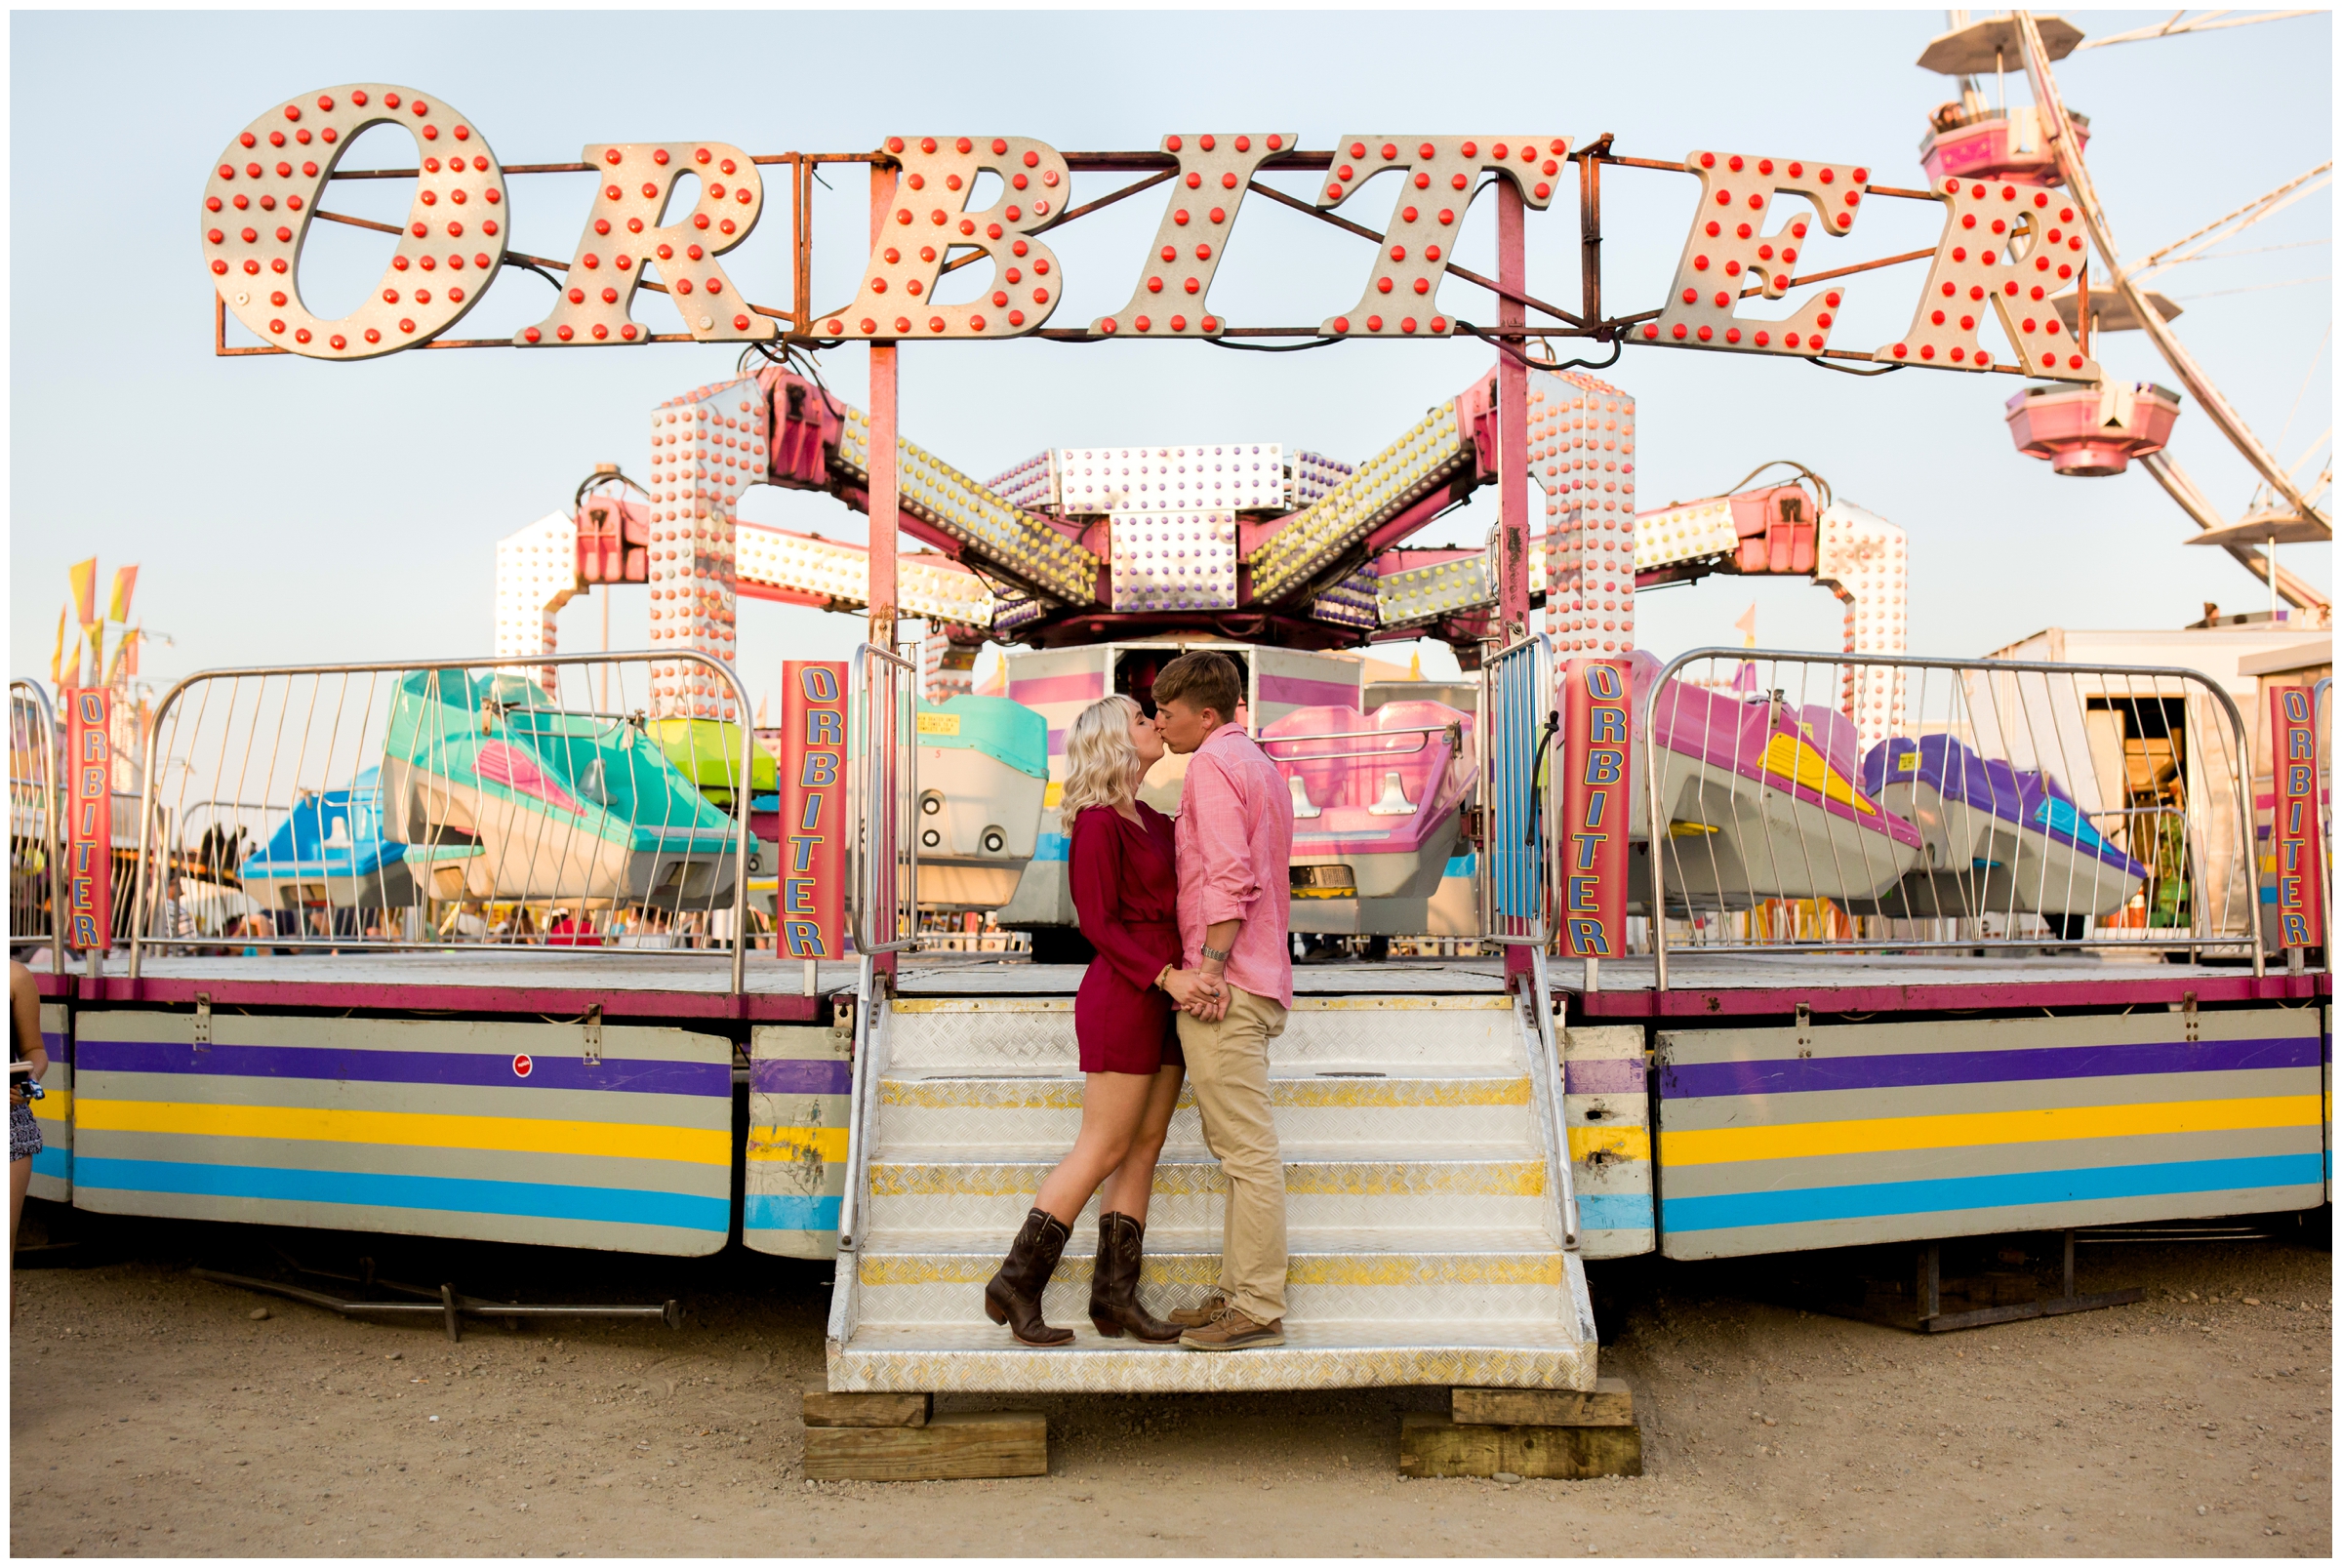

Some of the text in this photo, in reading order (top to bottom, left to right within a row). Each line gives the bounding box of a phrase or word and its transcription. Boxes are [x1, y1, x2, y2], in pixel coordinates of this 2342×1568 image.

[201, 83, 2099, 382] ORBITER
[72, 692, 107, 946] ORBITER
[784, 666, 843, 957] ORBITER
[1567, 663, 1628, 955] ORBITER
[2281, 690, 2313, 945] ORBITER
